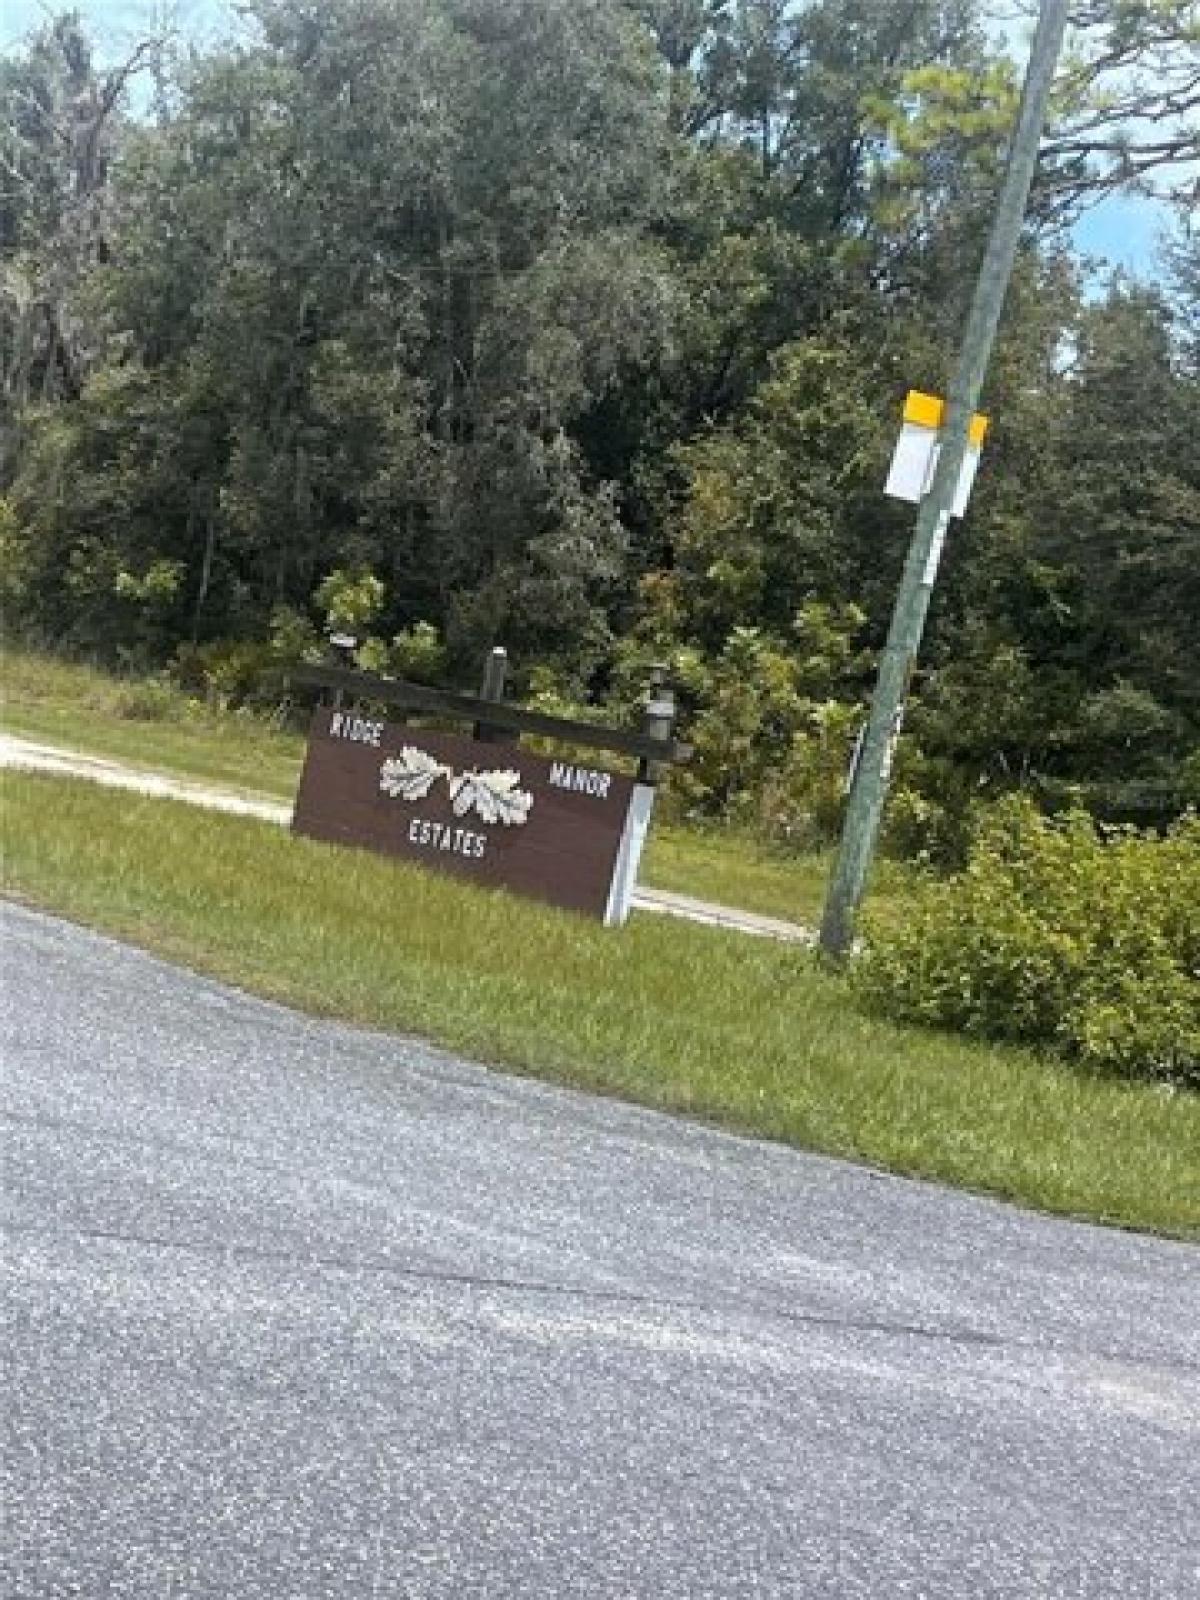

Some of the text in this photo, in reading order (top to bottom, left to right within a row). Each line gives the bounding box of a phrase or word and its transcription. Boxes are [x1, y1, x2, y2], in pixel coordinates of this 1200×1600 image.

[330, 712, 611, 798] RIDGE MANOR
[408, 819, 488, 858] ESTATES
